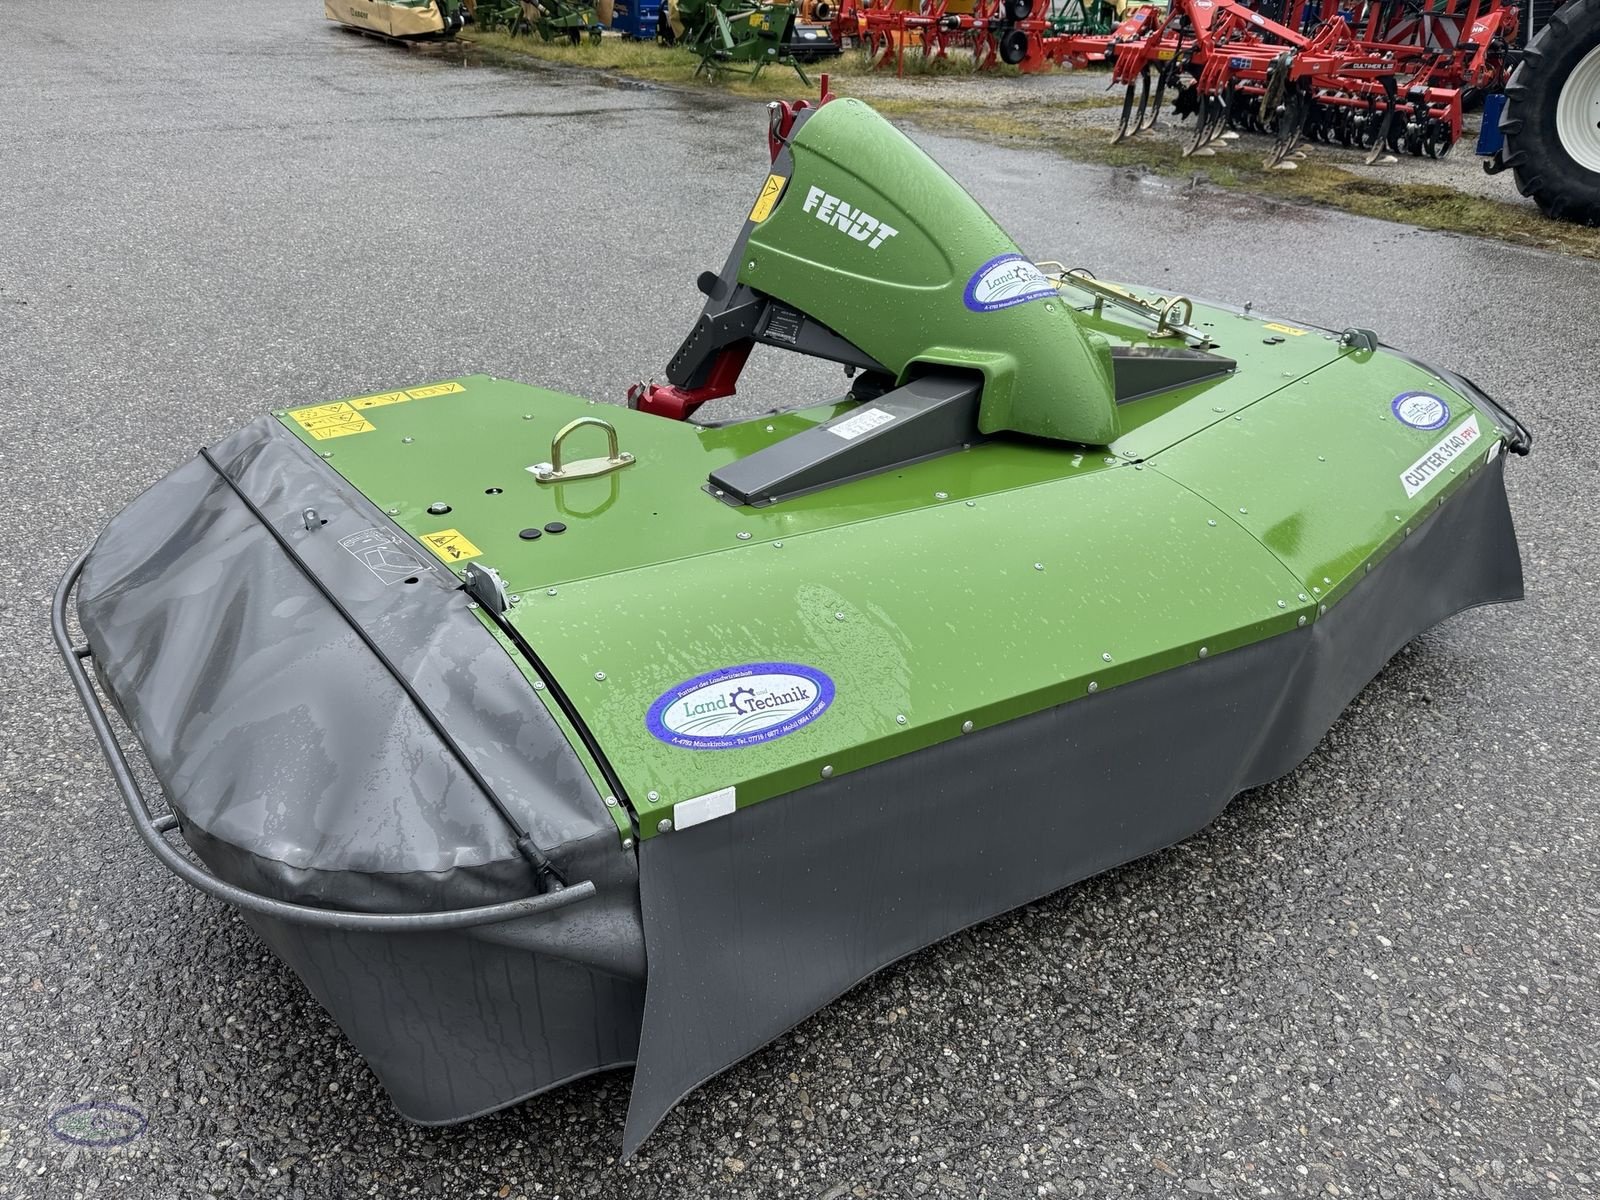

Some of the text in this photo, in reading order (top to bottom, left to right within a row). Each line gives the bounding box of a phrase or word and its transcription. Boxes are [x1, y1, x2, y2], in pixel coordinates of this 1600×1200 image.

[802, 185, 900, 250] FENDT
[985, 269, 1015, 290] Land
[1405, 426, 1478, 487] CUTTER 3140 FPV
[677, 684, 699, 698] Partner
[744, 685, 811, 713] Technik
[683, 694, 729, 718] Land
